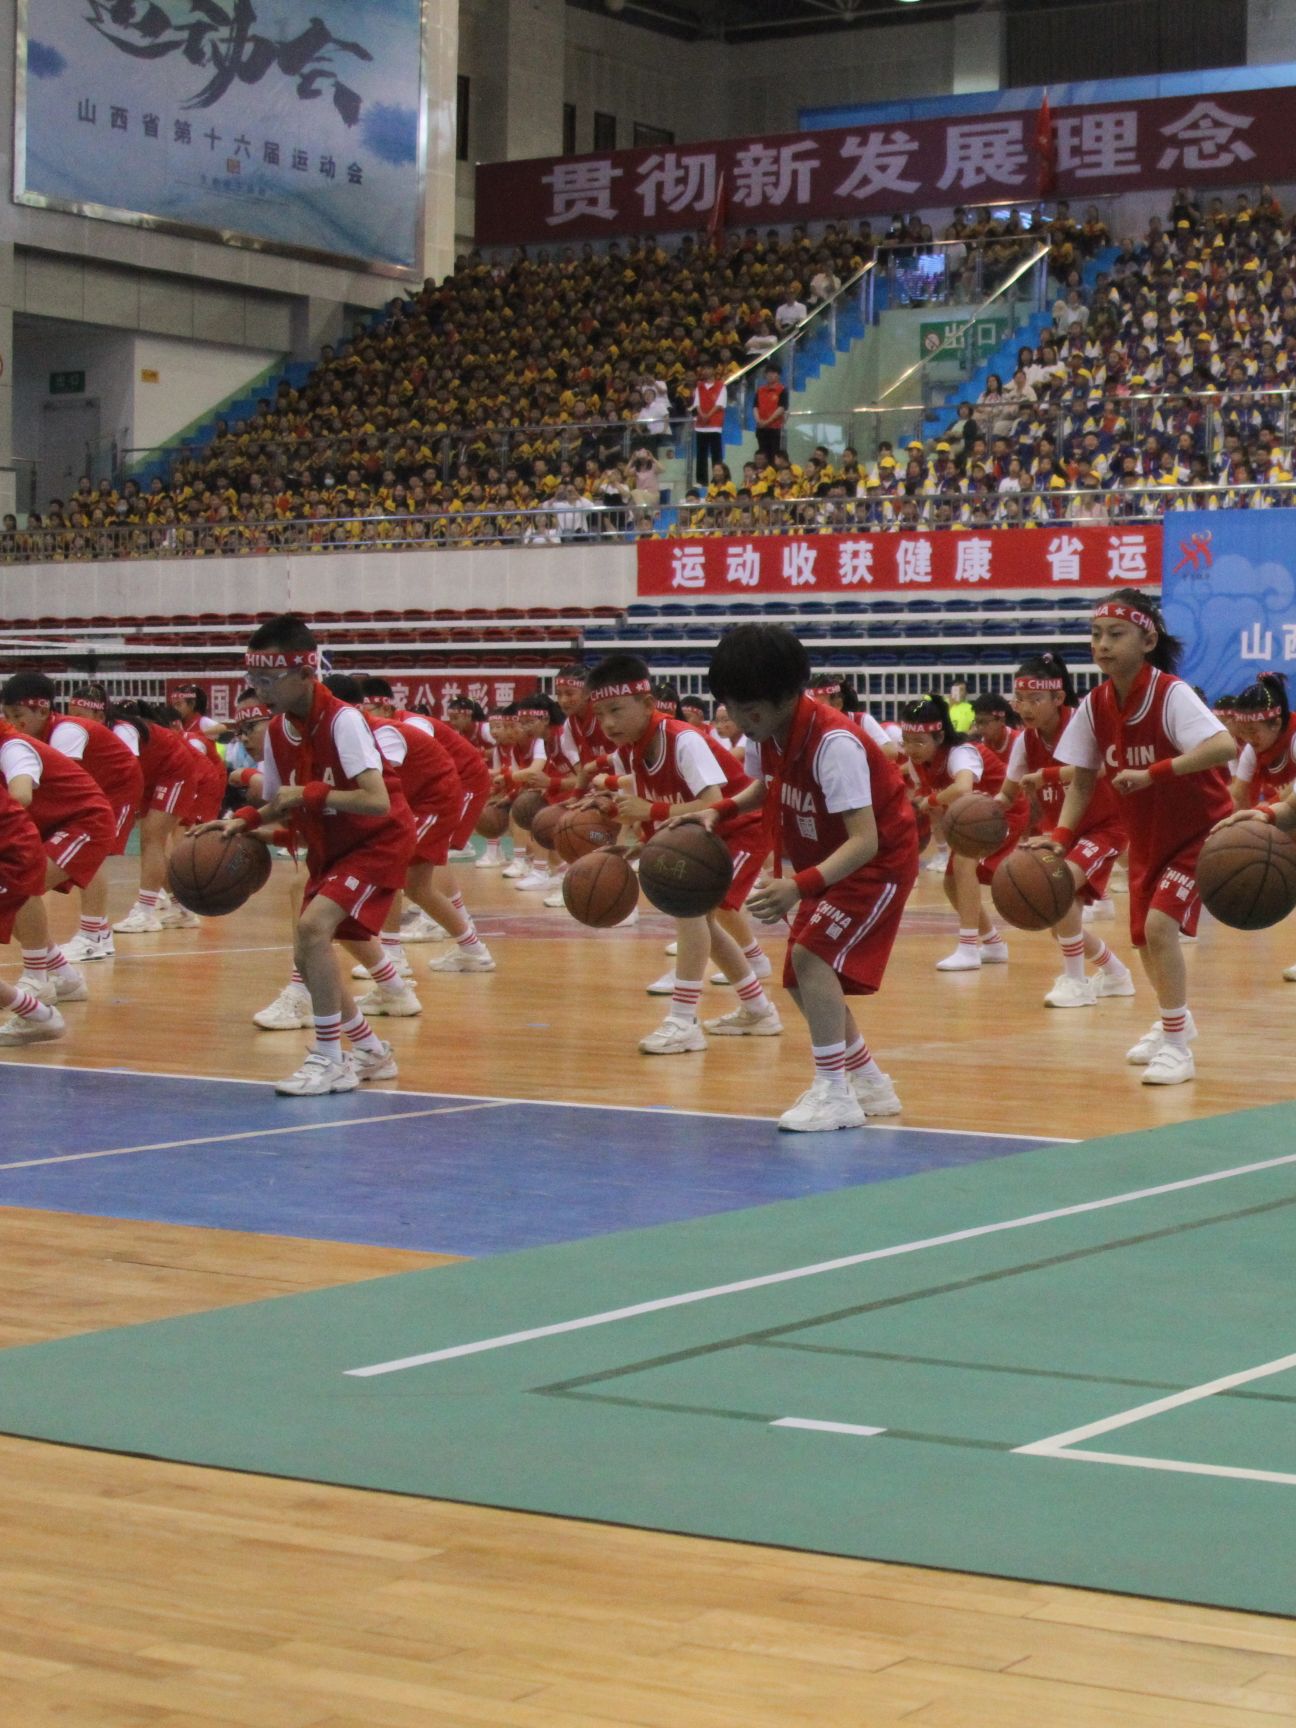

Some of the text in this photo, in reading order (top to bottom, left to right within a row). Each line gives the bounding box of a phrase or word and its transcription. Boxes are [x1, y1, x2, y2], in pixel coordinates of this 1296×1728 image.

[77, 98, 363, 186] 山西省第十六届运动会
[541, 101, 1257, 226] 贯彻新发展理念
[672, 536, 1148, 589] 运动收获健康 省运
[818, 900, 853, 929] CHINA
